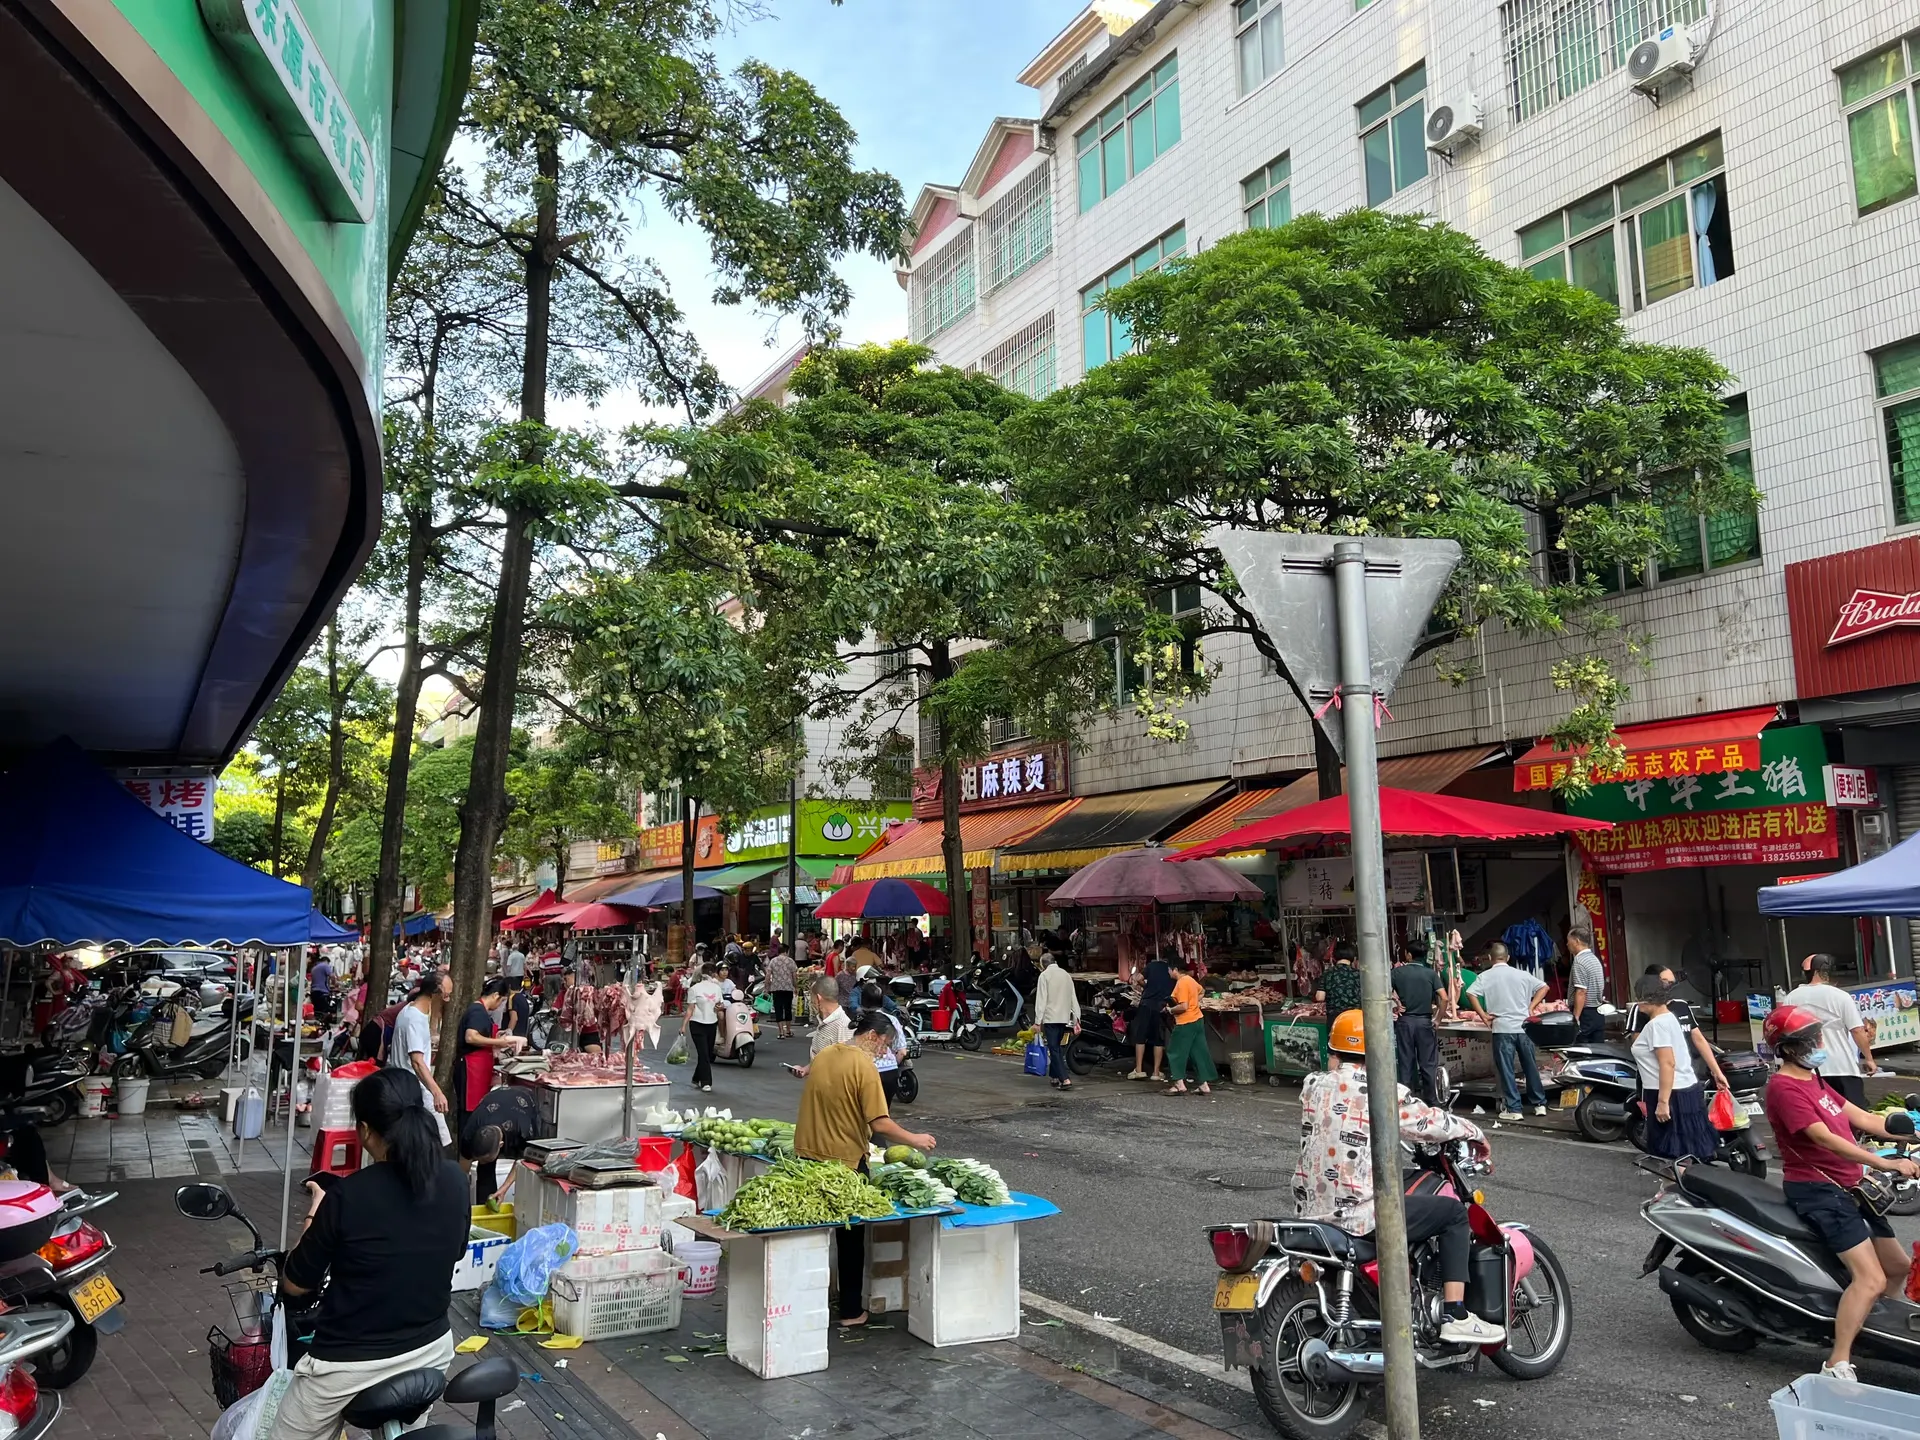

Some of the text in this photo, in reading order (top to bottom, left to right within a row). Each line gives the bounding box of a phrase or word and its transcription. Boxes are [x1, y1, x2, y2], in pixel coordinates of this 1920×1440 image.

[1529, 744, 1744, 787] 国家标志农产品
[1623, 755, 1808, 812] 中华土猪
[1836, 773, 1867, 800] 便利店
[1576, 804, 1829, 853] 新店开业热烈欢迎进店有礼送
[1762, 849, 1824, 862] 13825655992
[93, 1277, 105, 1290] Q
[83, 1286, 117, 1317] 59F11
